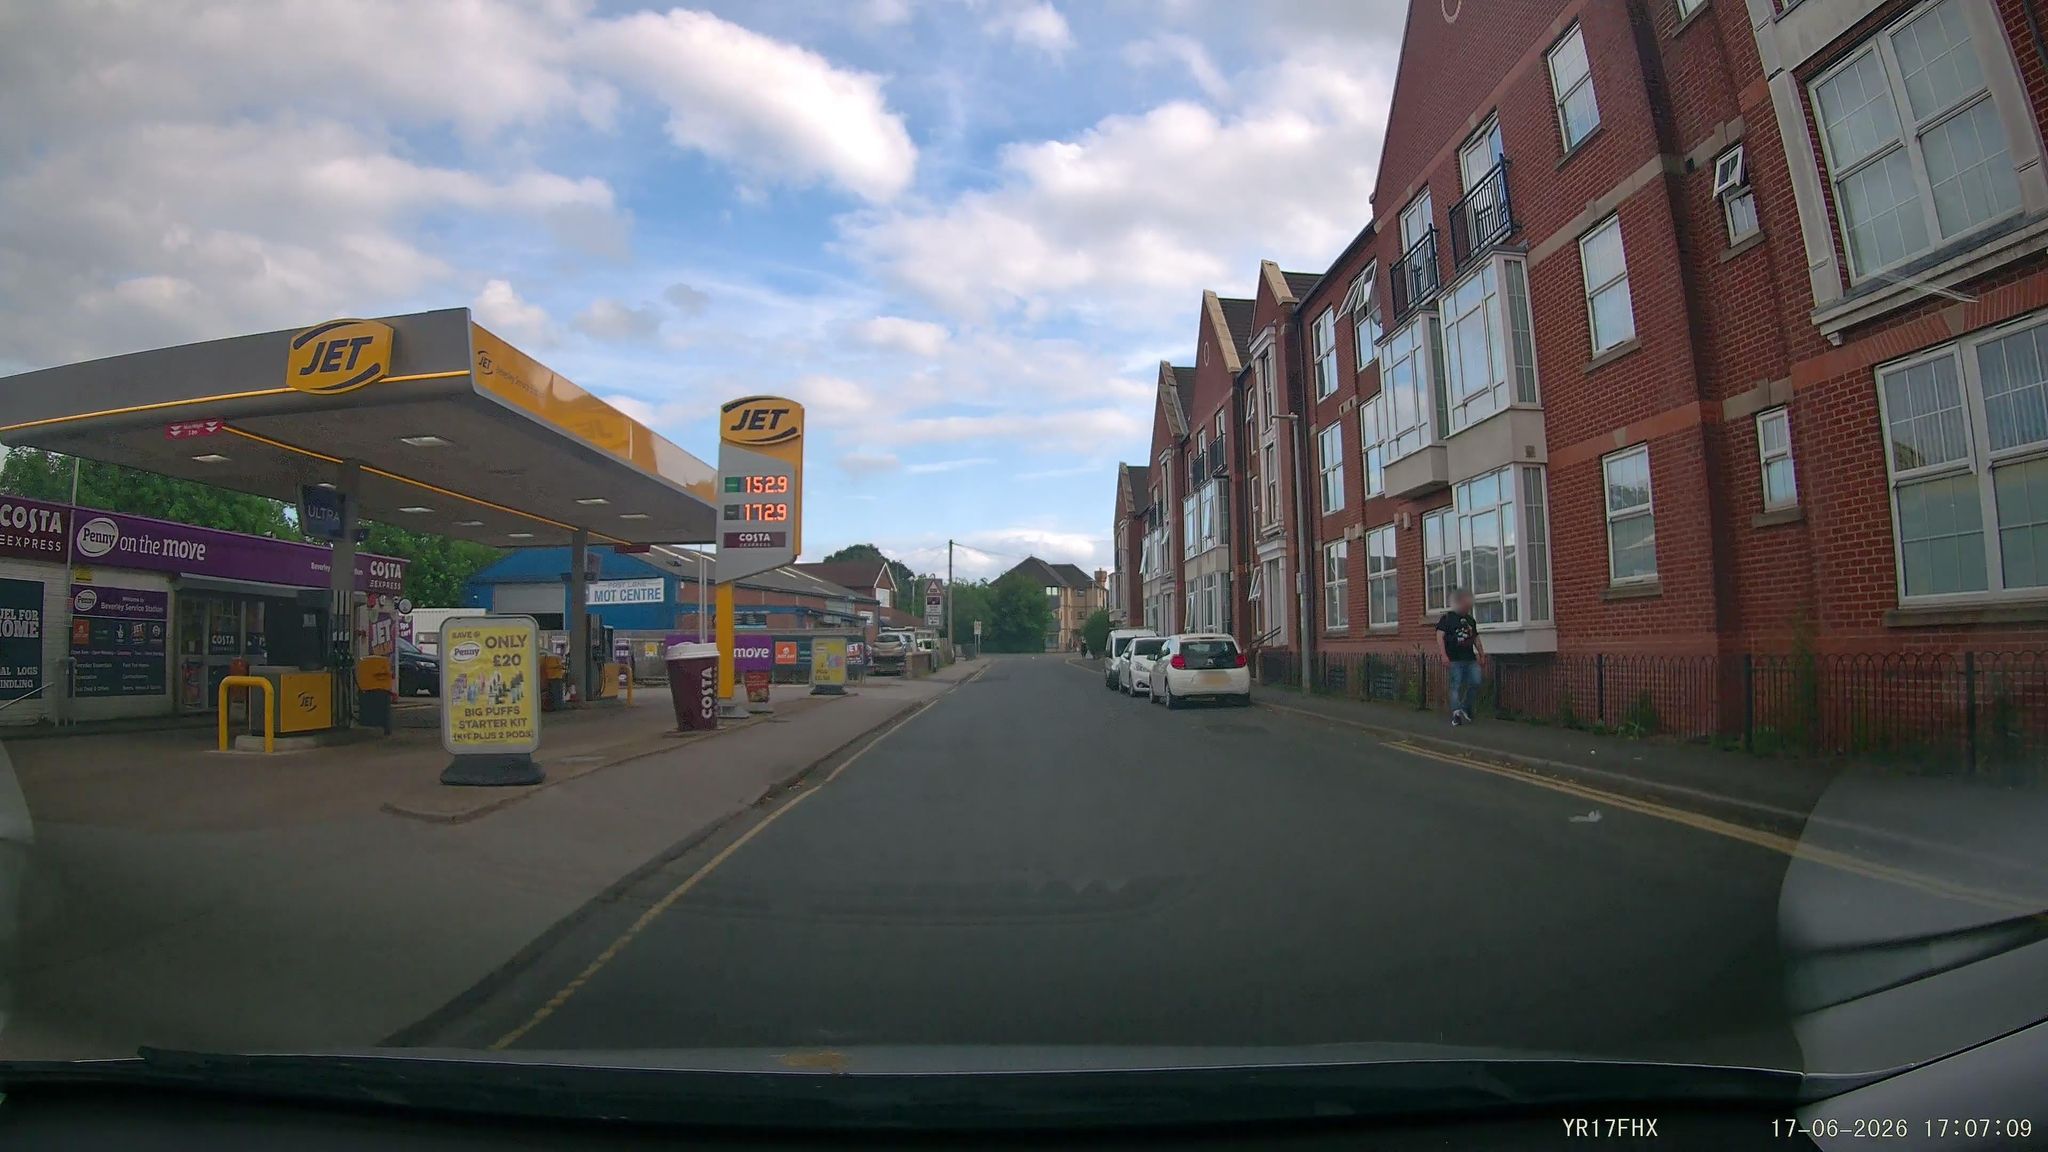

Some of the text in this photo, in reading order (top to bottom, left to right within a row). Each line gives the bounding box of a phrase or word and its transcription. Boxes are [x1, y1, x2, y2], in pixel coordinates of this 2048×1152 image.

[300, 336, 373, 376] JET
[478, 356, 493, 370] JET
[730, 408, 790, 431] JET
[745, 476, 788, 493] 152.9
[0, 504, 62, 534] COSTA
[308, 505, 340, 521] ULTRA
[744, 504, 787, 521] 172.9
[7, 535, 62, 552] EXPRESS
[83, 527, 206, 561] Penny on the move
[738, 533, 771, 542] COSTA
[310, 562, 331, 573] Beverley
[370, 560, 402, 579] COSTA
[374, 580, 401, 590] EXPRESS
[594, 587, 661, 602] MOT CENTRE
[125, 603, 144, 612] Service
[18, 609, 39, 620] FOR
[0, 619, 39, 638] OME
[212, 635, 235, 646] COSTA
[485, 634, 528, 649] ONLY
[454, 645, 480, 657] Penny
[733, 646, 769, 658] move
[492, 654, 522, 667] £20
[17, 666, 38, 676] LOGS
[0, 679, 34, 689] INDLING
[701, 666, 714, 719] COSTA
[300, 695, 314, 708] JET
[464, 706, 520, 717] BIG PUFFS
[458, 717, 528, 729] STARTER KIT
[473, 732, 496, 740] PLUS
[499, 731, 505, 739] 2
